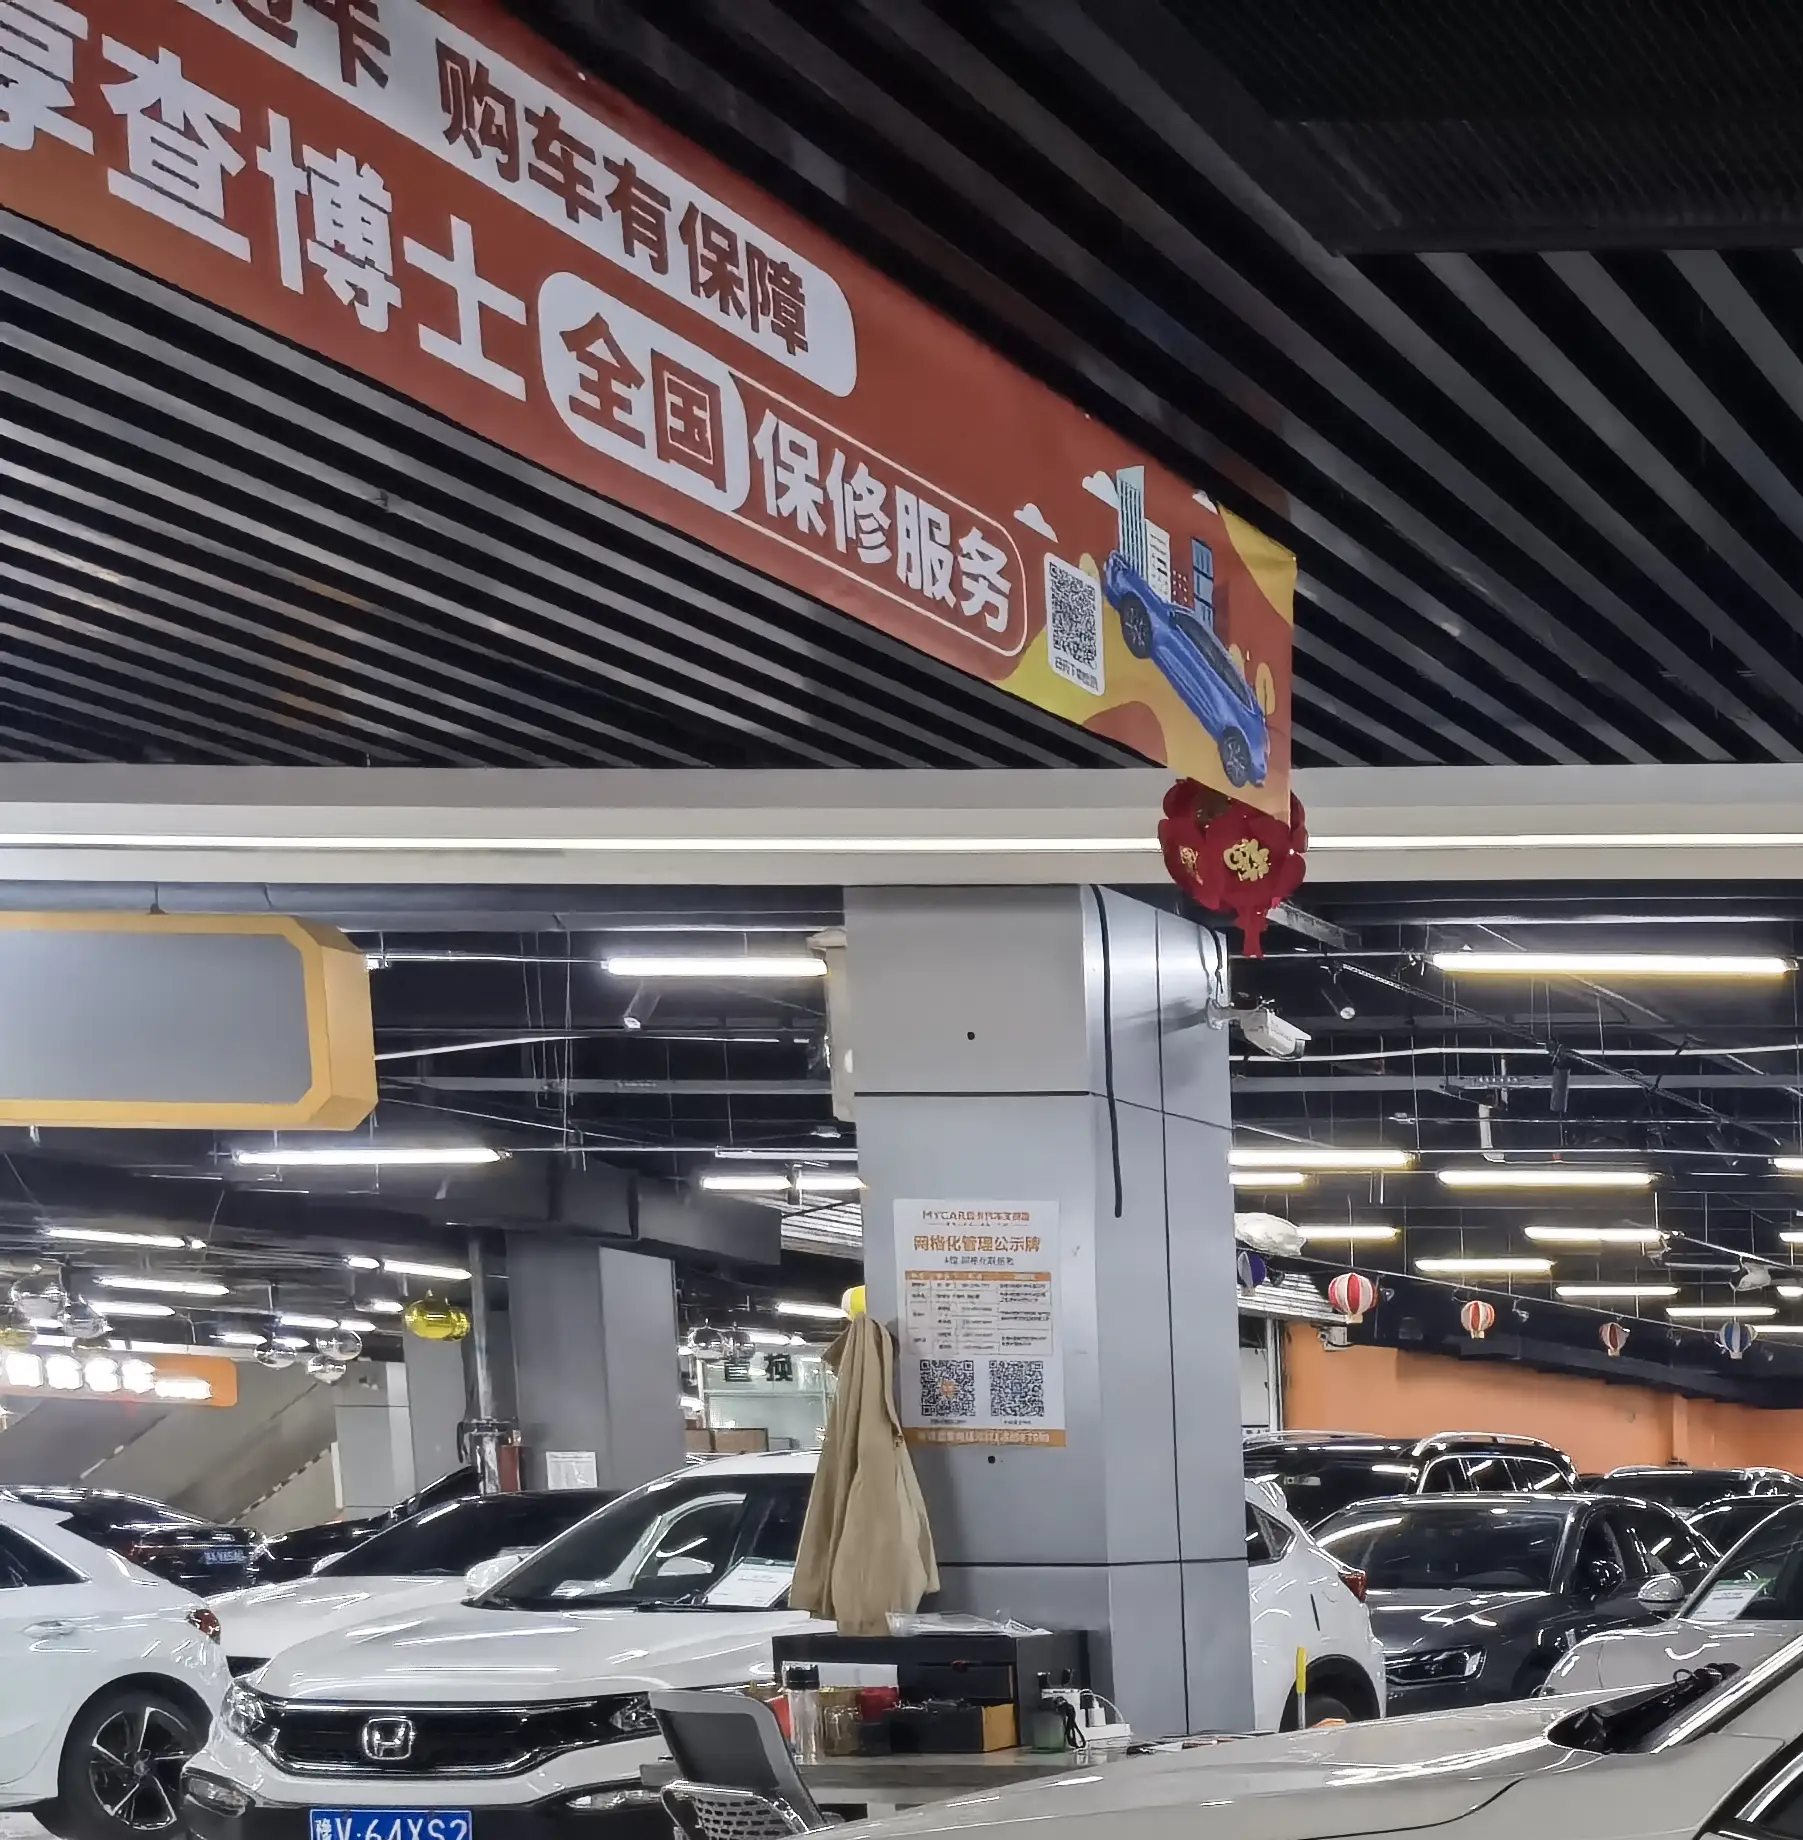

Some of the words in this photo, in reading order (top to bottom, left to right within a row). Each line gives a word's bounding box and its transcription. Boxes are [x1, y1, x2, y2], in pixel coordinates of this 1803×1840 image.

[436, 37, 809, 356] 购车有保障
